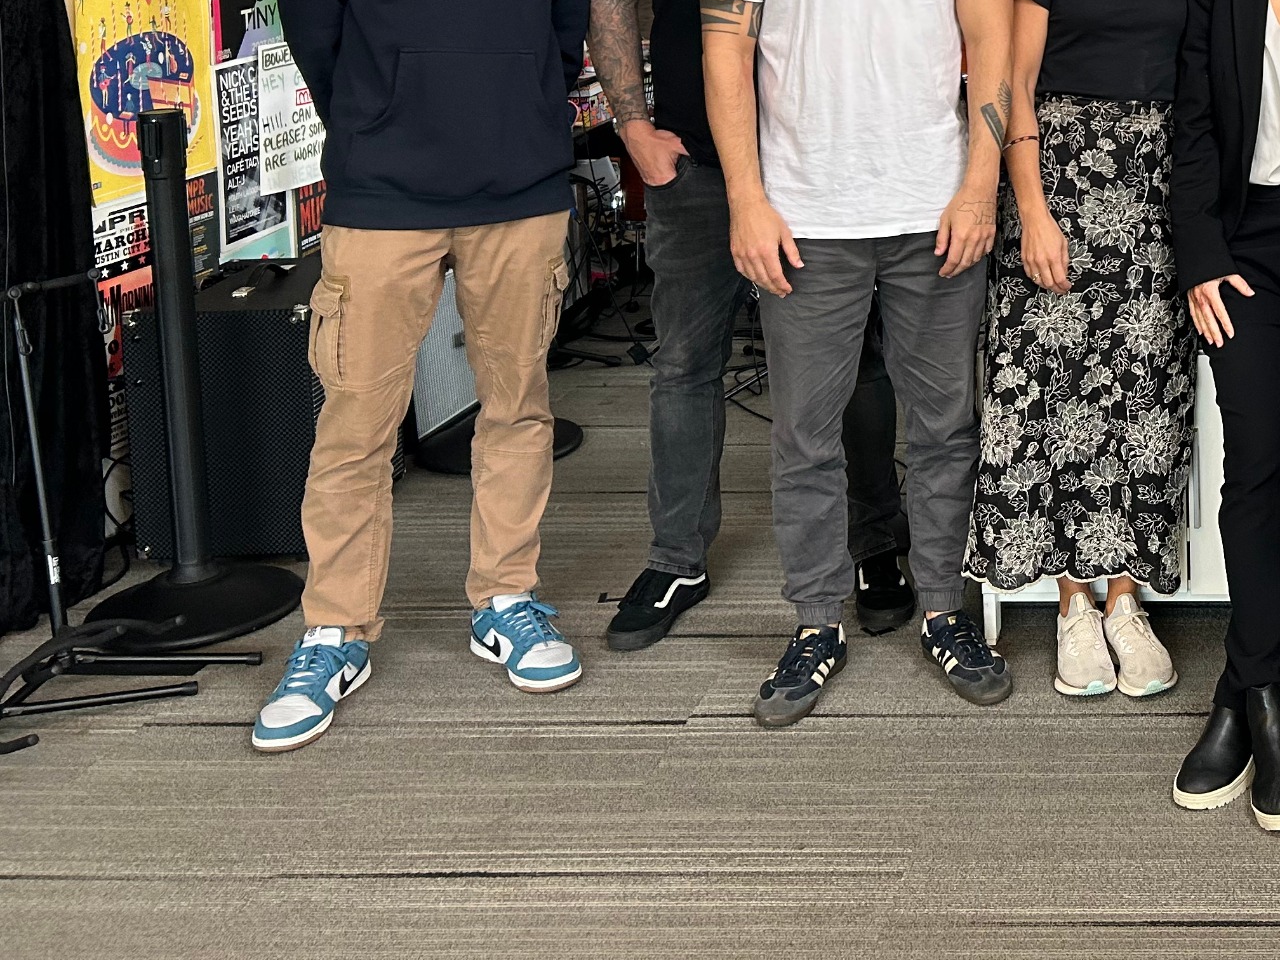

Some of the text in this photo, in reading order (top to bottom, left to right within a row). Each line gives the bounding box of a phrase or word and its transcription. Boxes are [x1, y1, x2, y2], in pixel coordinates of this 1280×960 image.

[240, 2, 277, 32] TINY
[220, 68, 246, 91] NICK
[262, 72, 285, 93] HEY
[222, 98, 258, 123] SEEDS
[291, 106, 312, 123] CAN
[223, 120, 253, 144] YEAH
[263, 125, 306, 153] PLEASE?
[224, 134, 259, 160] YEAHS
[264, 152, 287, 173] ARE
[187, 177, 206, 199] NPR
[227, 174, 246, 191] ALT-J
[188, 193, 214, 217] MUSIC
[122, 243, 141, 257] CITY
